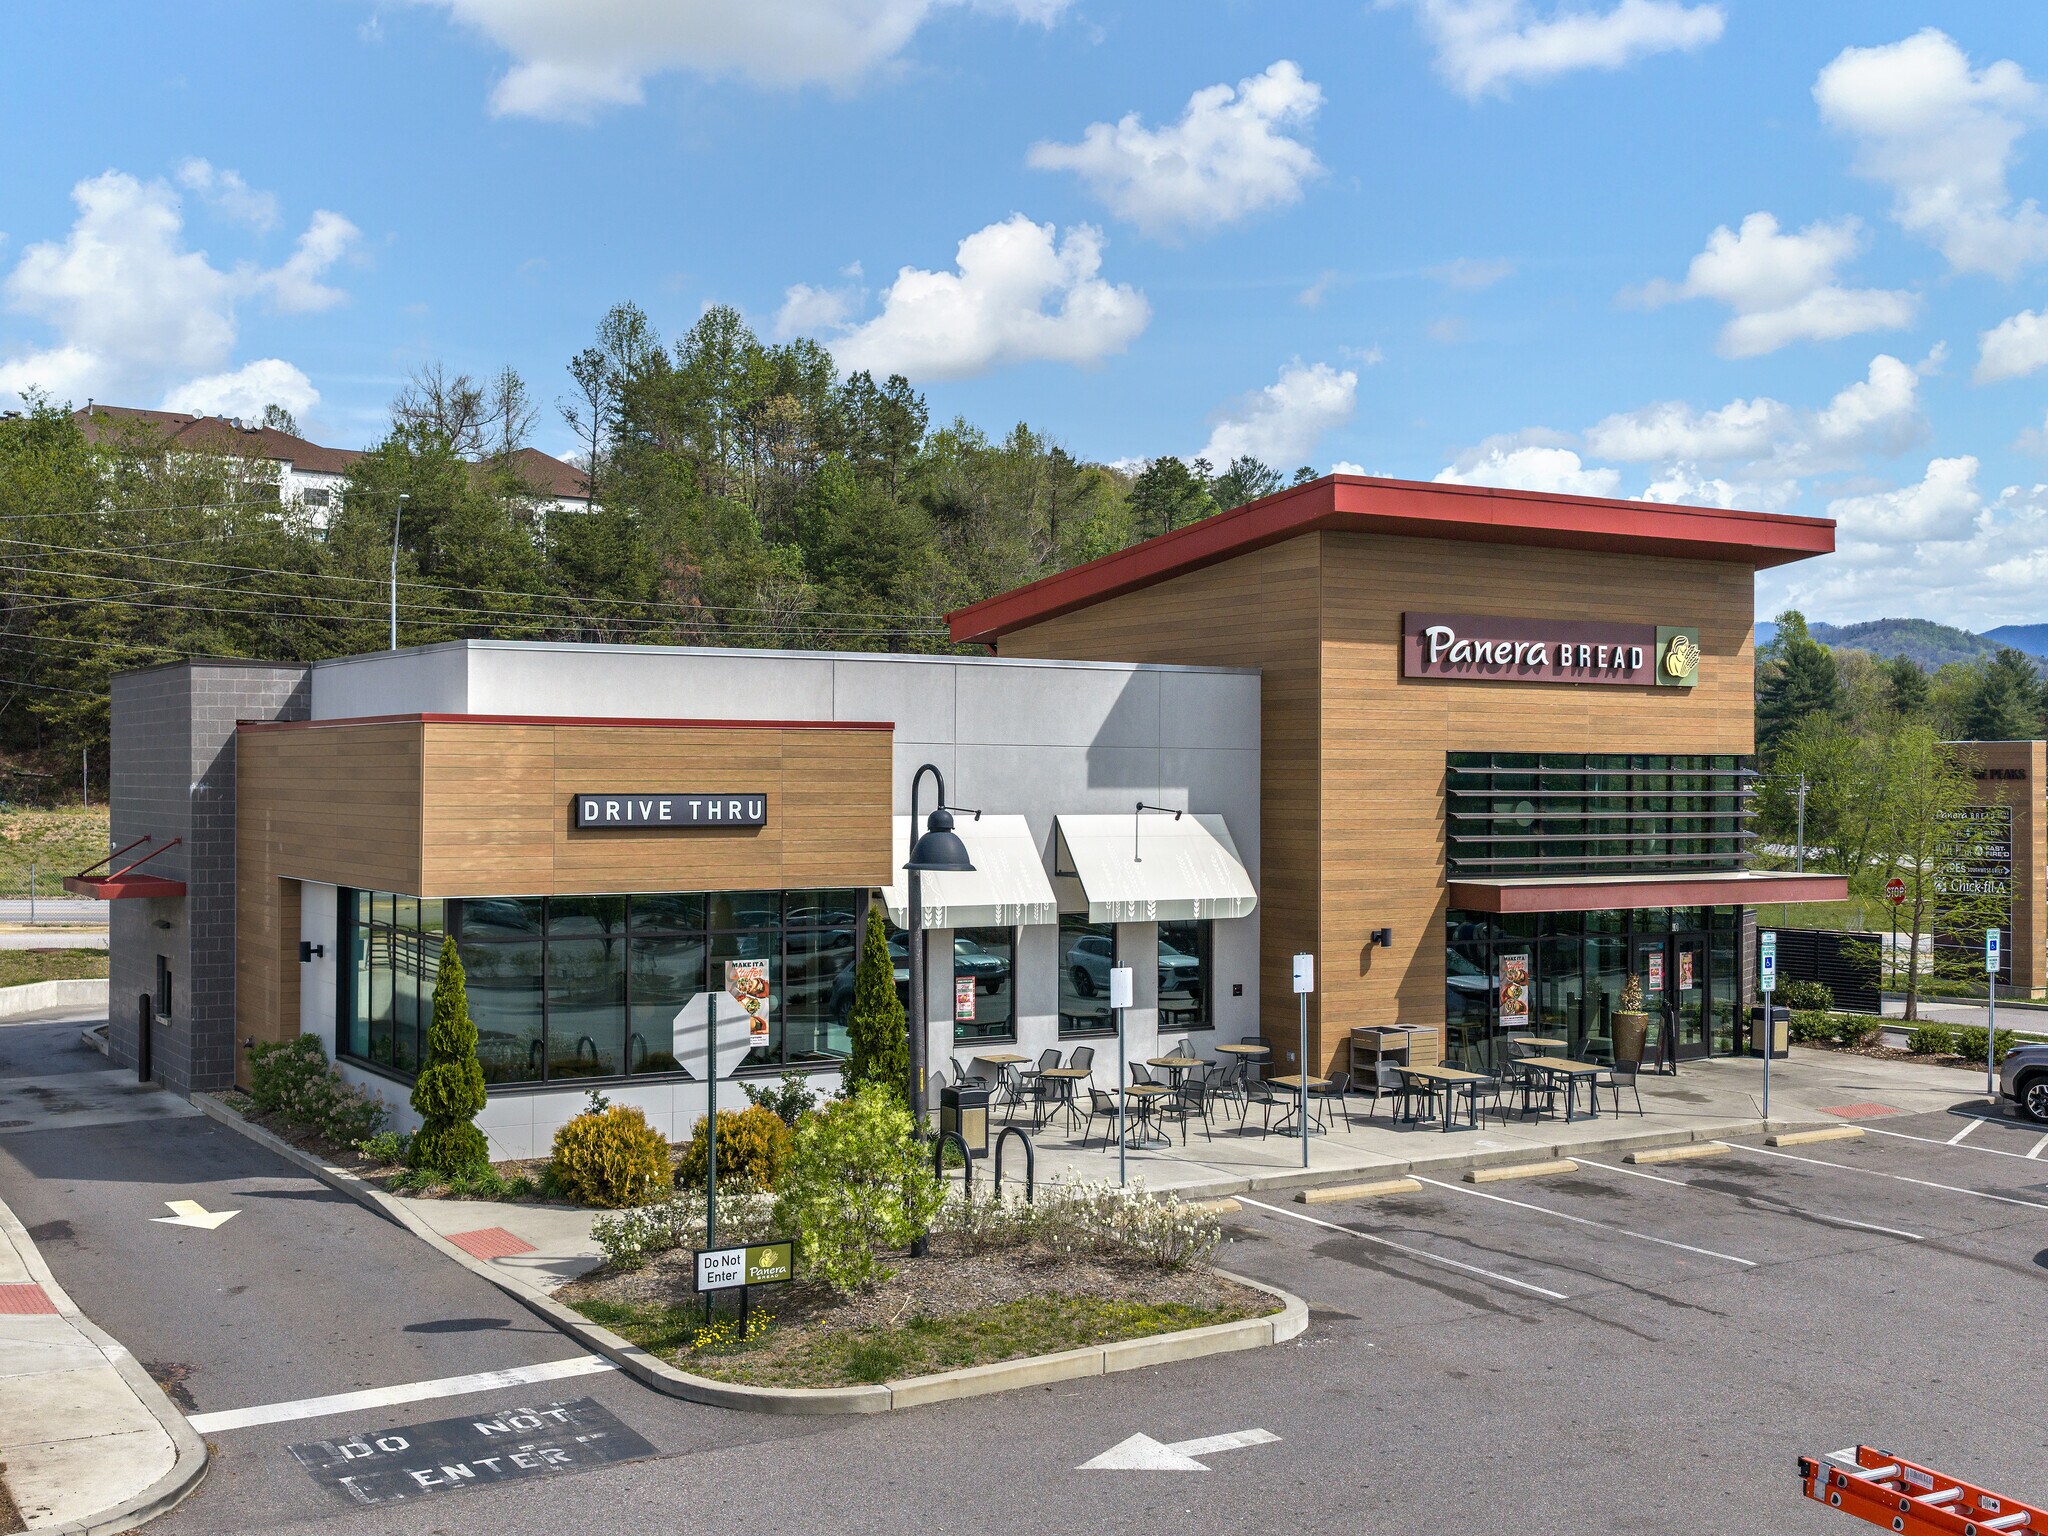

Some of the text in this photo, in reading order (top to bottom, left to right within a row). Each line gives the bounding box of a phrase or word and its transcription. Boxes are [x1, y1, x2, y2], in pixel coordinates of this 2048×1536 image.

[1425, 625, 1643, 671] Panera BREAD
[584, 800, 762, 821] DRIVE THRU
[1886, 886, 1905, 898] STOP
[1951, 879, 2007, 894] Chick-filA
[704, 1254, 741, 1269] Do Not
[707, 1270, 738, 1283] Enter
[749, 1265, 787, 1277] Panera
[338, 1407, 572, 1464] DO NOT
[410, 1446, 574, 1487] ENTER
